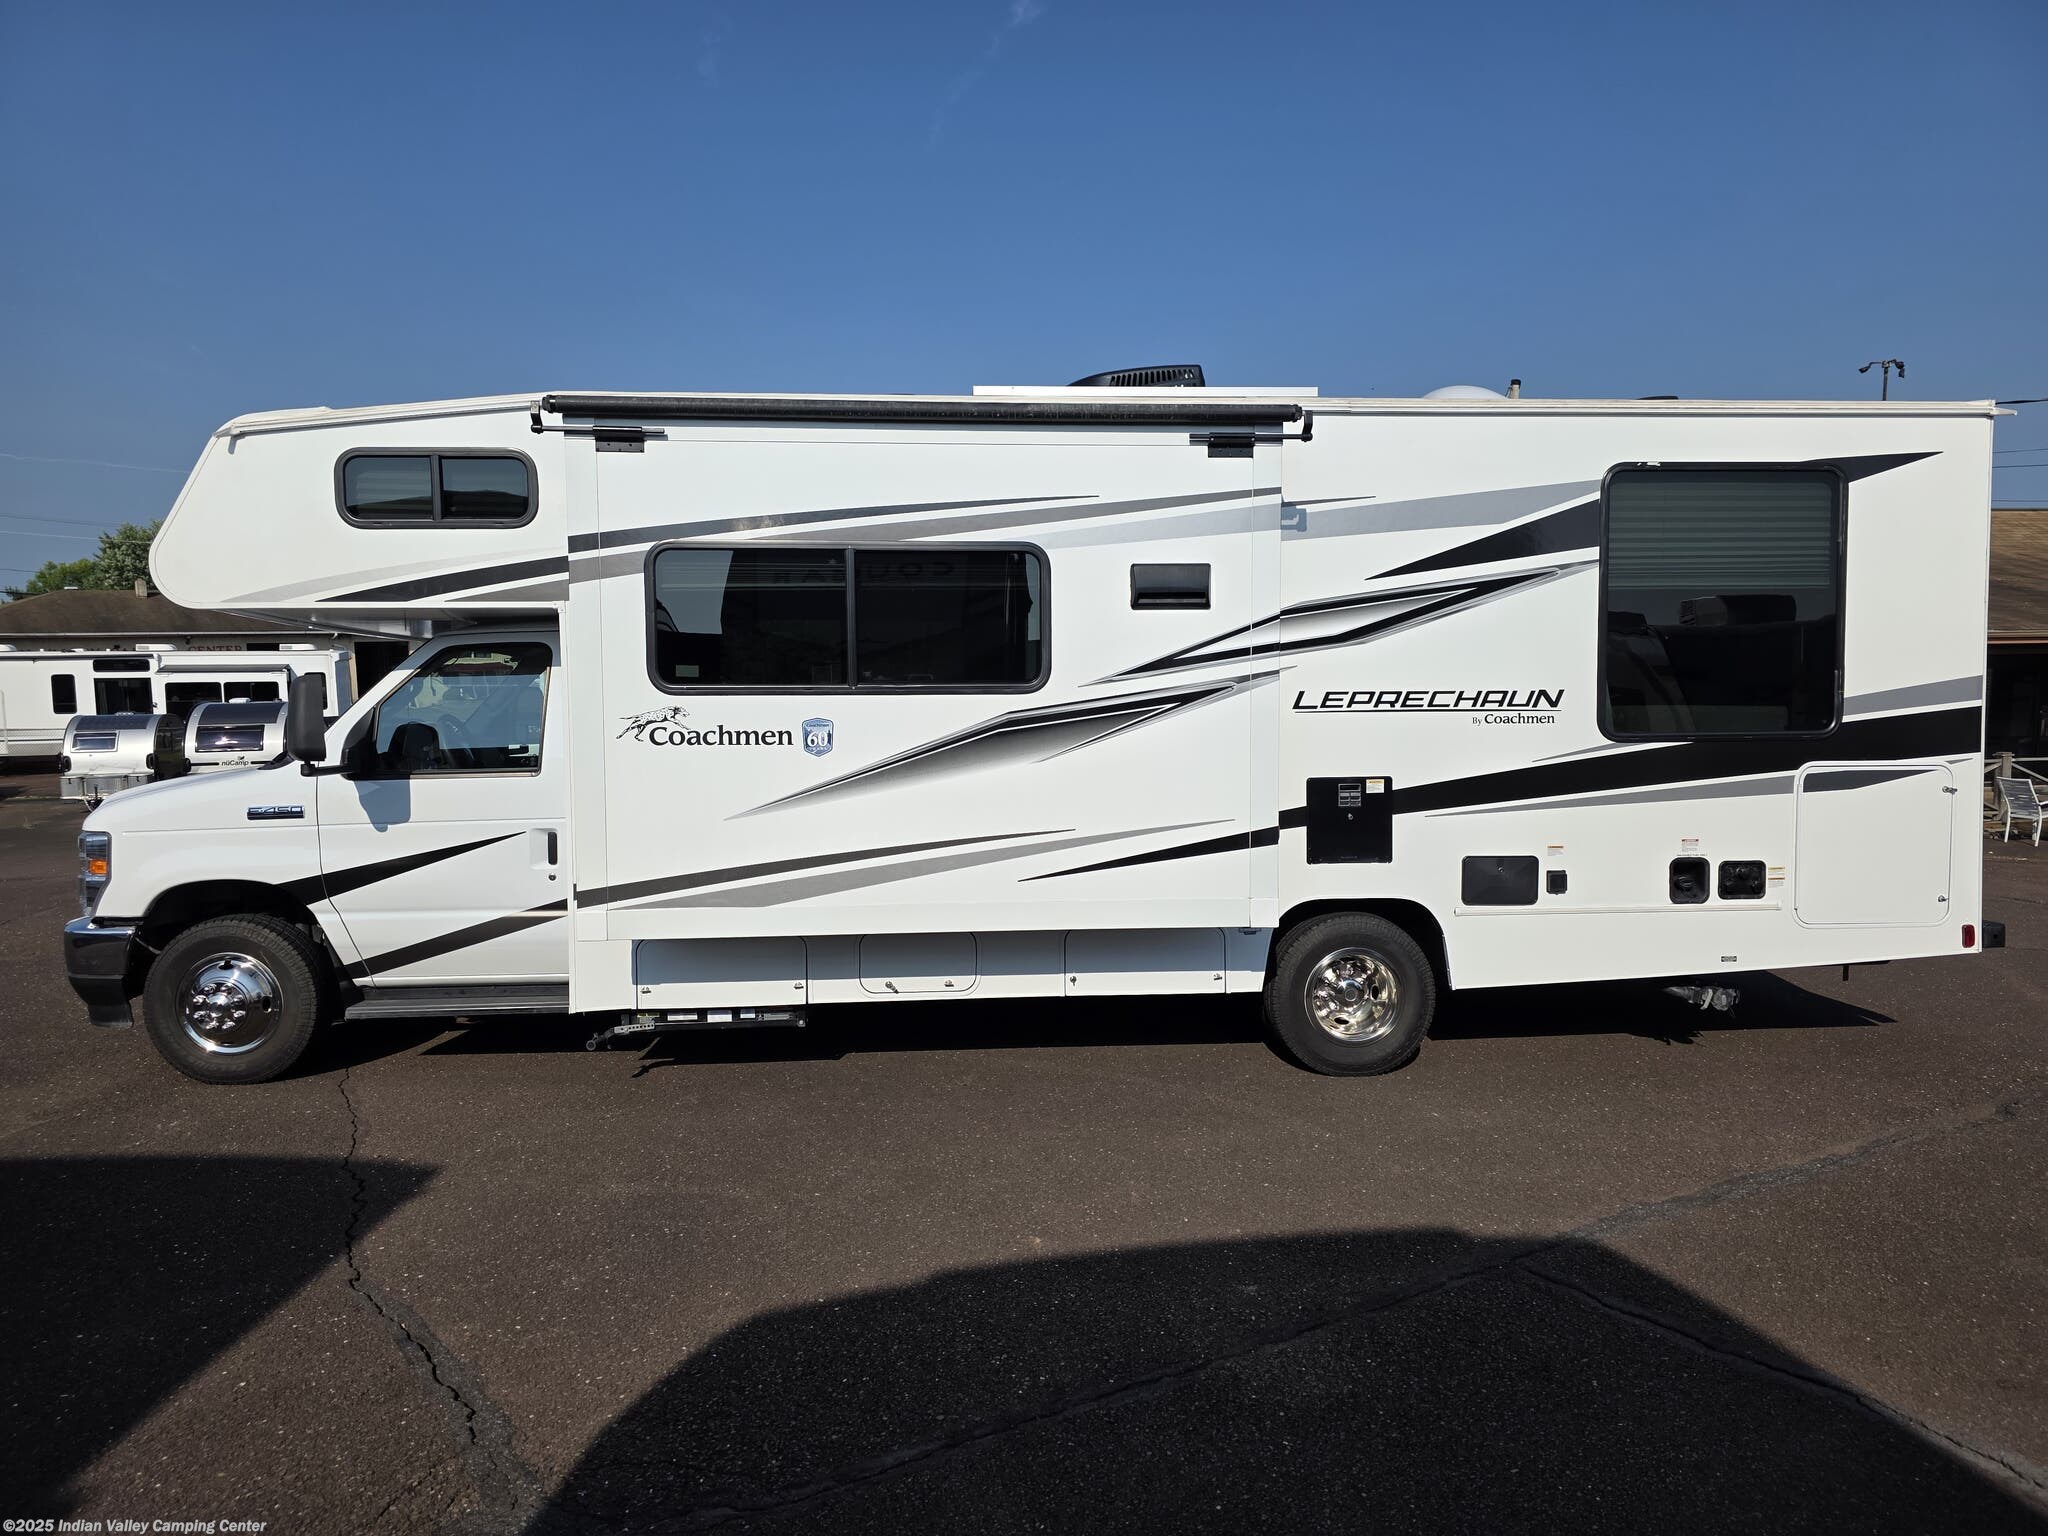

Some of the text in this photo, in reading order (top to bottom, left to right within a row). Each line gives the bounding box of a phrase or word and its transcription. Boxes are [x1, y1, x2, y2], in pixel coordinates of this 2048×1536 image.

[1292, 689, 1565, 709] LEPRECHAUN
[1472, 713, 1555, 727] By Coachmen
[648, 725, 794, 746] Coachmen
[807, 731, 829, 747] 60
[221, 759, 249, 767] nüCamp
